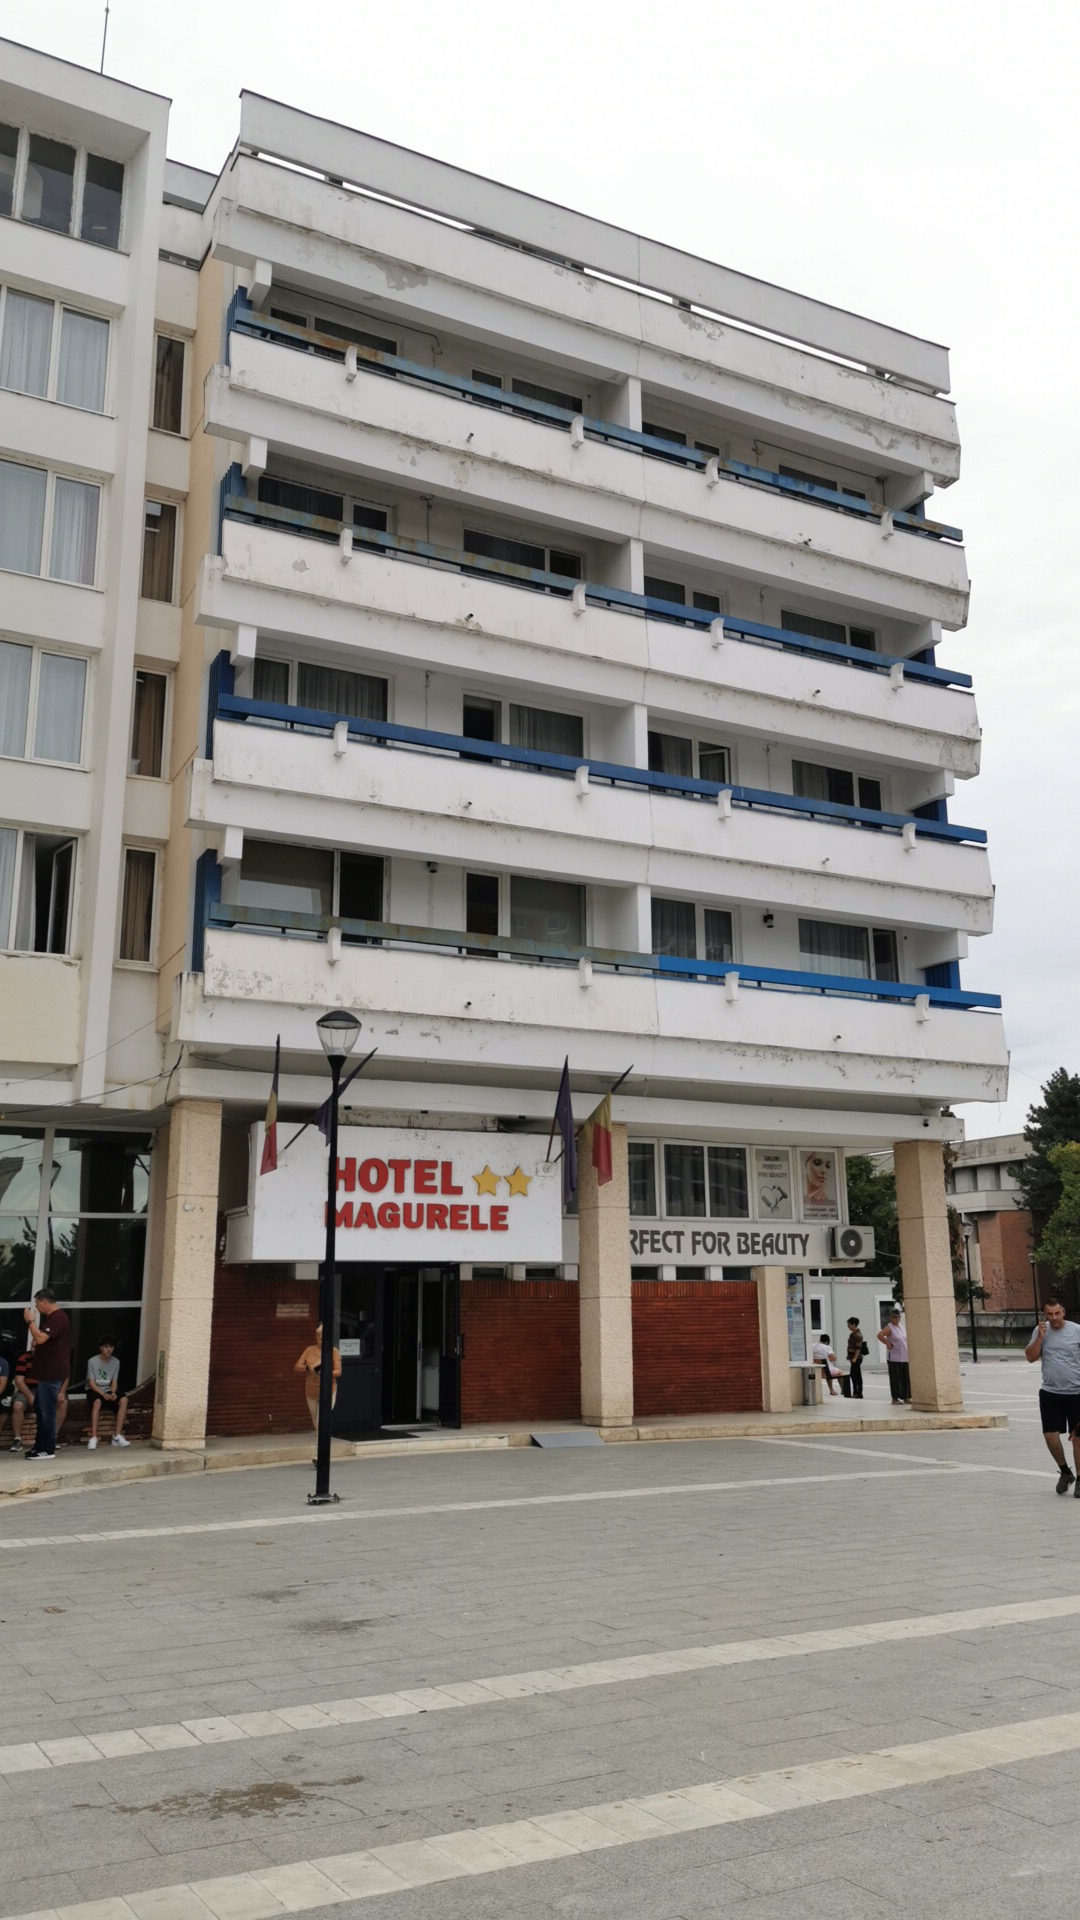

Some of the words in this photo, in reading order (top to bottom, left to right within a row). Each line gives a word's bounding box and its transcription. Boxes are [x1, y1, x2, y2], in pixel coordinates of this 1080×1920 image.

[335, 1157, 463, 1195] HOTEL
[325, 1201, 509, 1231] MAGURELE
[629, 1229, 685, 1256] RFECT
[691, 1231, 731, 1256] FOR
[736, 1232, 810, 1258] BEAUTY
